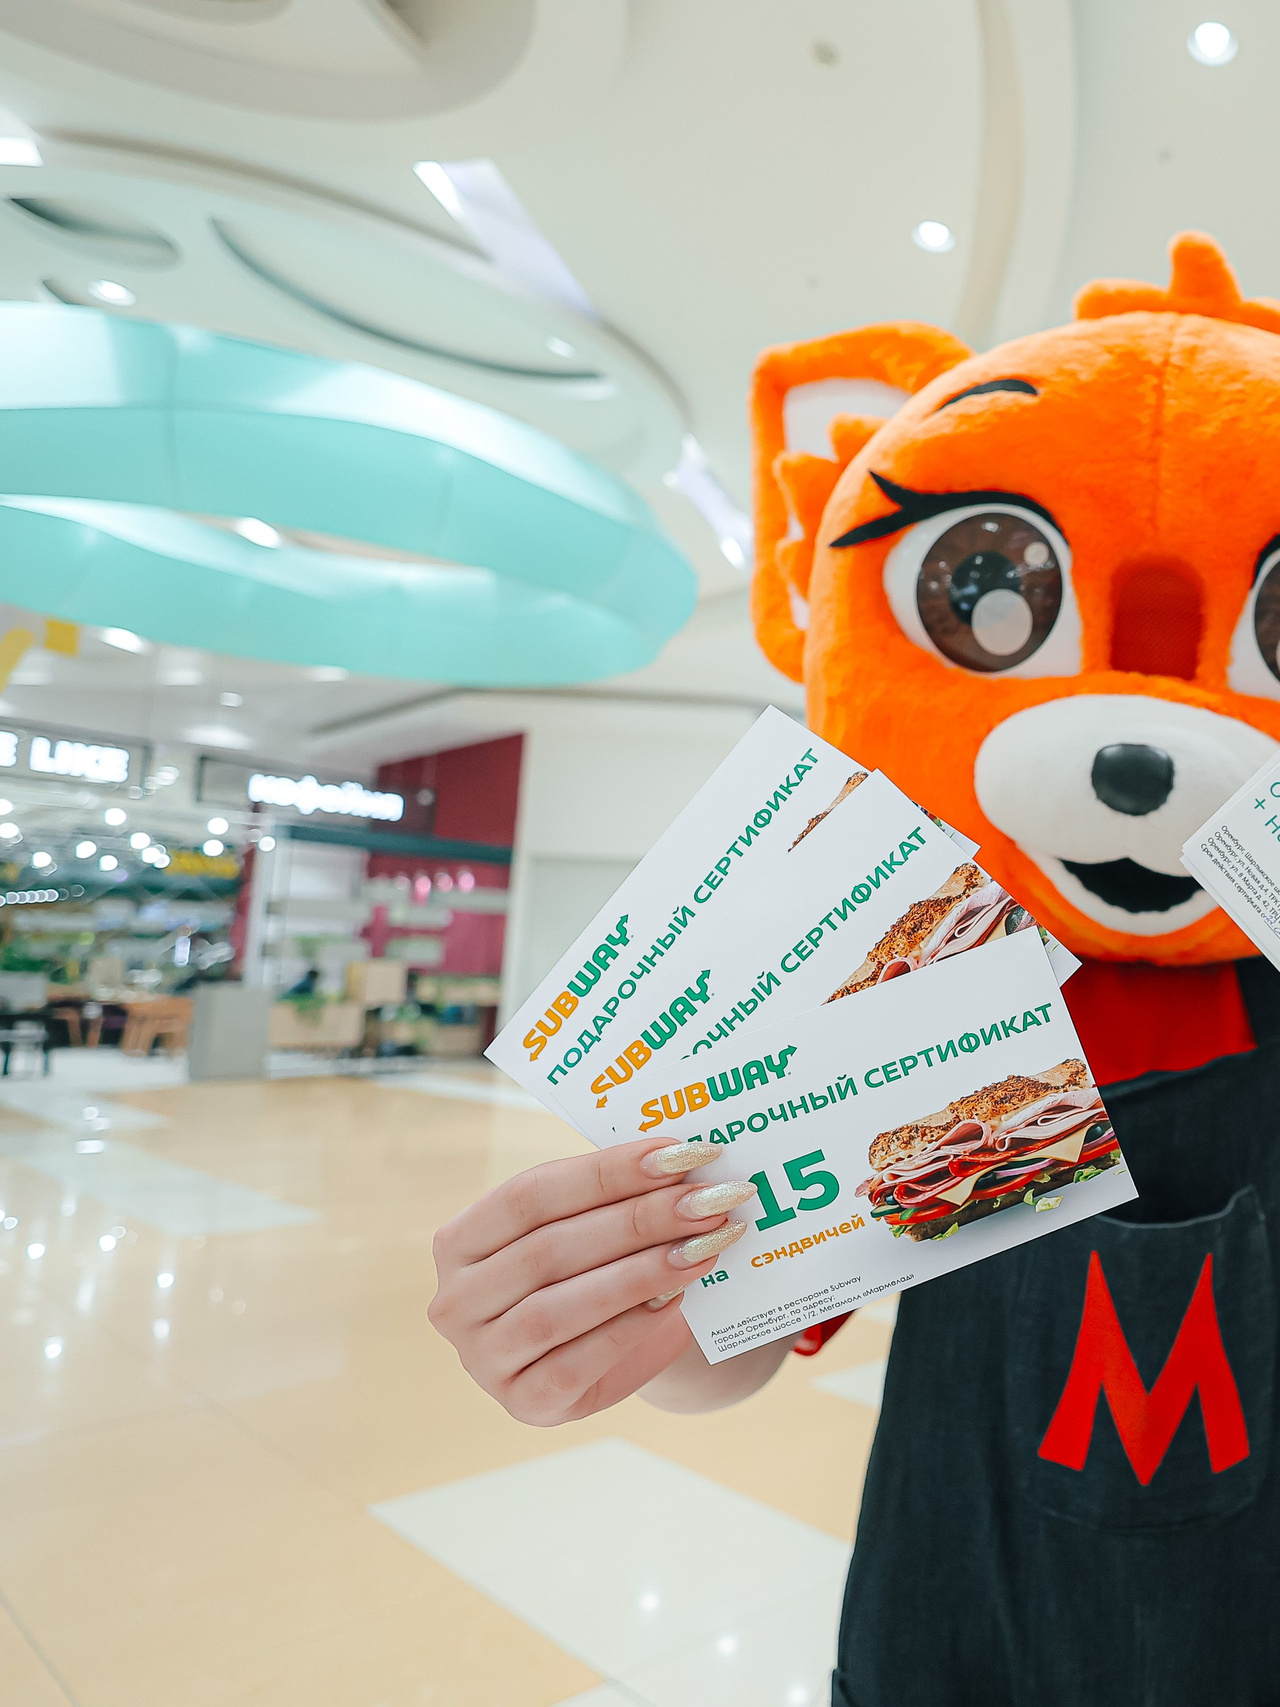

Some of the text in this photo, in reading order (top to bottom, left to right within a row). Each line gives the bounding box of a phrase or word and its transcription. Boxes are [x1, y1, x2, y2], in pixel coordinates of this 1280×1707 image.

[1254, 798, 1266, 810] +
[1201, 844, 1214, 859] Срок
[1212, 858, 1235, 883] действия
[1208, 837, 1232, 866] Оренбург,
[1229, 864, 1238, 873] ул.
[1242, 877, 1258, 895] Марта
[1262, 900, 1270, 910] 42,
[1269, 907, 1280, 921] ТРЦ
[1214, 831, 1239, 860] Оренбург,
[1236, 859, 1245, 868] ул.
[1245, 866, 1261, 885] Новая
[1269, 892, 1280, 905] ТРК
[1221, 825, 1245, 854] Оренбург,
[1245, 852, 1275, 887] Шарлыкское
[547, 747, 820, 1086] ПОДАРОЧНЫЙ СЕРТИФИКАТ
[779, 826, 928, 973] СЕРТИФИКАТ
[523, 914, 630, 1062] SUBWAY
[590, 968, 712, 1109] SUBWAY
[688, 1002, 1054, 1146] АРОЧНЫЙ СЕРТИФИКАТ
[637, 1045, 798, 1133] SUBWAY
[751, 1148, 840, 1232] 15
[700, 1213, 866, 1288] на сэндвичей
[711, 1325, 735, 1338] Акция
[735, 1308, 776, 1328] действует
[784, 1289, 829, 1310] ресторане
[830, 1276, 863, 1291] Subway
[714, 1330, 744, 1345] города
[790, 1306, 801, 1316] по
[716, 1329, 771, 1352] Шарлыкское
[772, 1317, 801, 1331] шоссе
[819, 1295, 862, 1314] Мегамолл
[862, 1271, 916, 1297] «Мармелад»
[1037, 1250, 1250, 1486] М
